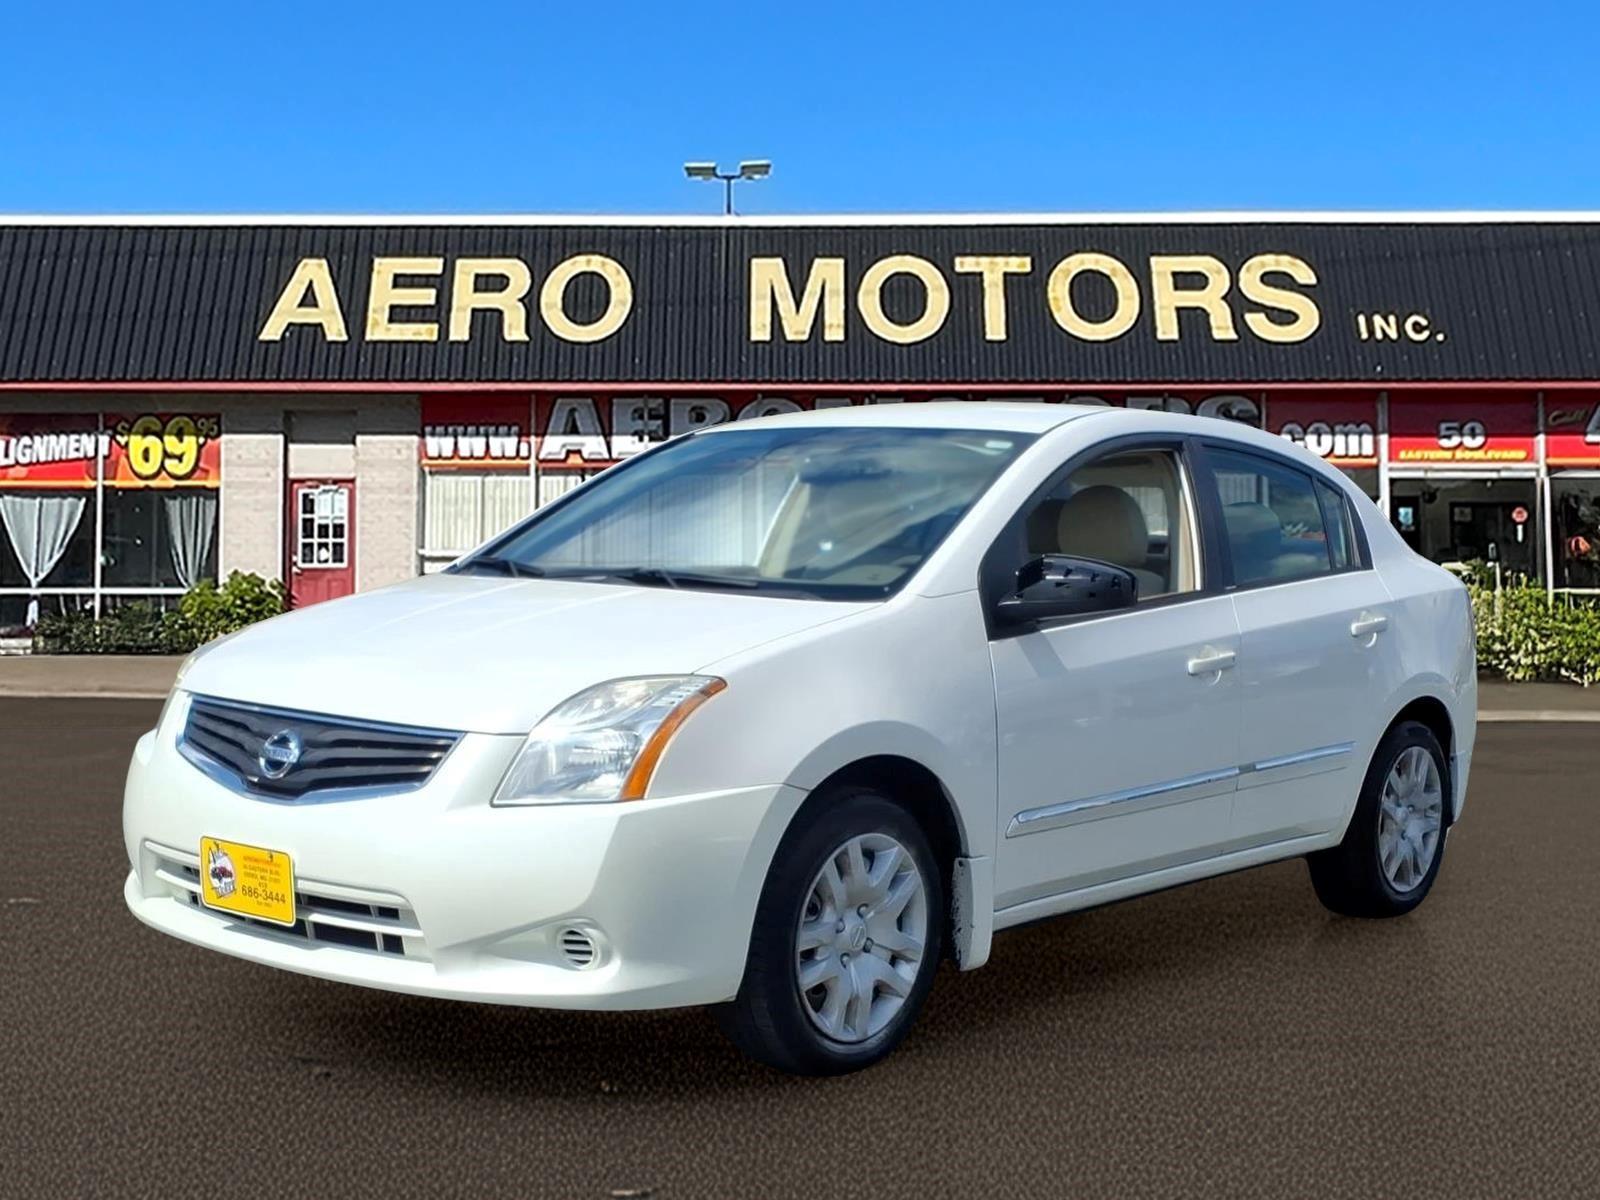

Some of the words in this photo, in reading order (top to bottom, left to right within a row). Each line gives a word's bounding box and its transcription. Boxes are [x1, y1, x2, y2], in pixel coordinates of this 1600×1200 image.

[258, 253, 633, 343] AERO
[749, 251, 1322, 345] MOTORS
[1356, 313, 1446, 342] INC.
[1437, 421, 1486, 449] 50
[241, 884, 286, 904] 686-3444
